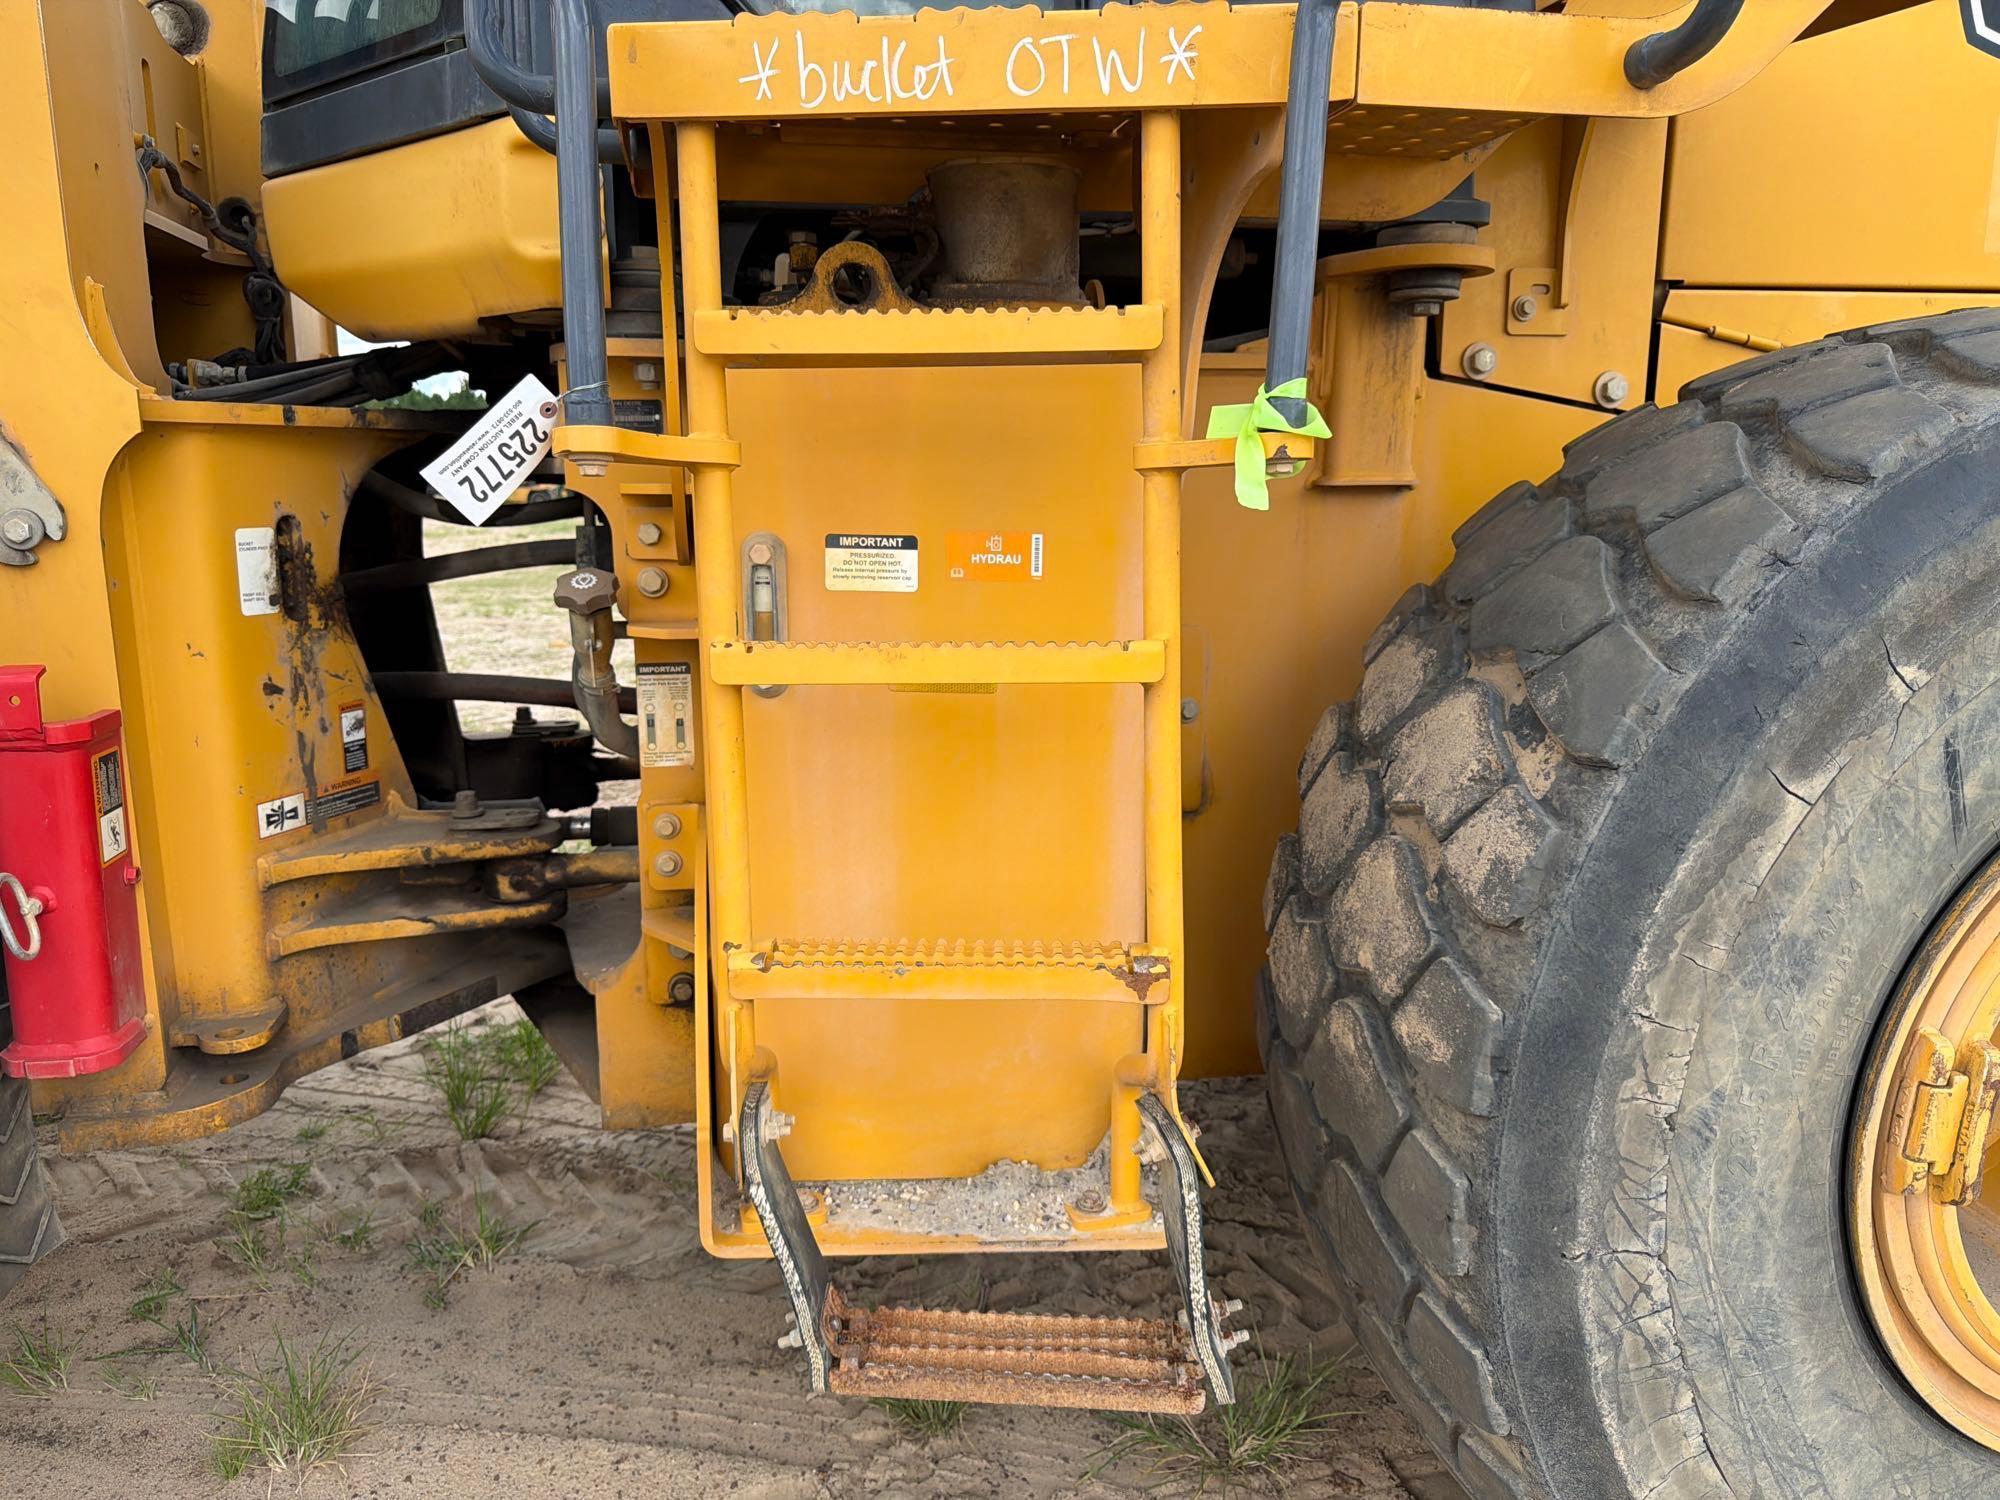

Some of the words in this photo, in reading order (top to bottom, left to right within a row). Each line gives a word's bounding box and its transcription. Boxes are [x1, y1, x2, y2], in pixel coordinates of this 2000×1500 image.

[503, 410, 524, 430] REBEL
[479, 428, 504, 452] AUCTION
[451, 452, 480, 478] COMPANY
[457, 417, 549, 503] 225772
[840, 536, 904, 547] IMPORTANT
[971, 554, 1022, 564] HYDRAU
